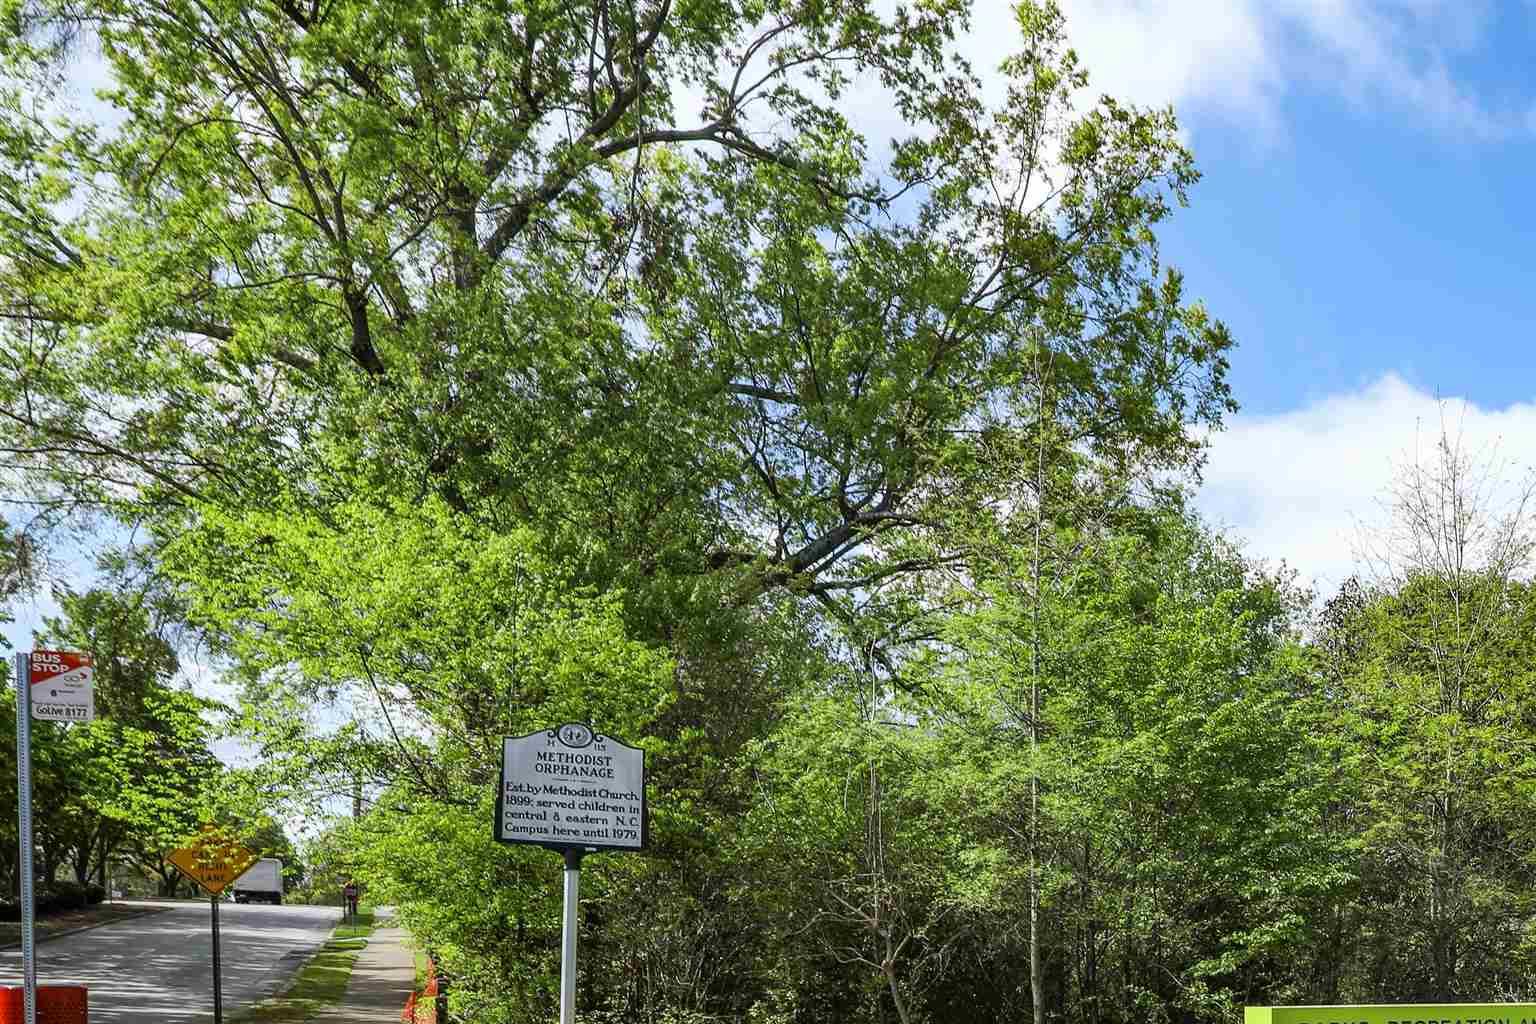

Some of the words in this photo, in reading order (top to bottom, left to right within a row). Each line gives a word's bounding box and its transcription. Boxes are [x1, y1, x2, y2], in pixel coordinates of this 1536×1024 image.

[33, 652, 60, 663] BUS
[32, 663, 70, 673] STOP
[537, 751, 612, 767] METHODIST
[535, 763, 615, 778] ORPHANAGE
[527, 783, 541, 795] by
[543, 784, 597, 798] Methodist
[536, 800, 575, 810] served
[578, 800, 625, 813] children
[629, 804, 640, 815] in
[505, 810, 547, 821] central
[566, 814, 608, 825] eastern
[505, 822, 549, 835] Campus
[552, 825, 580, 837] here
[583, 827, 609, 838] until
